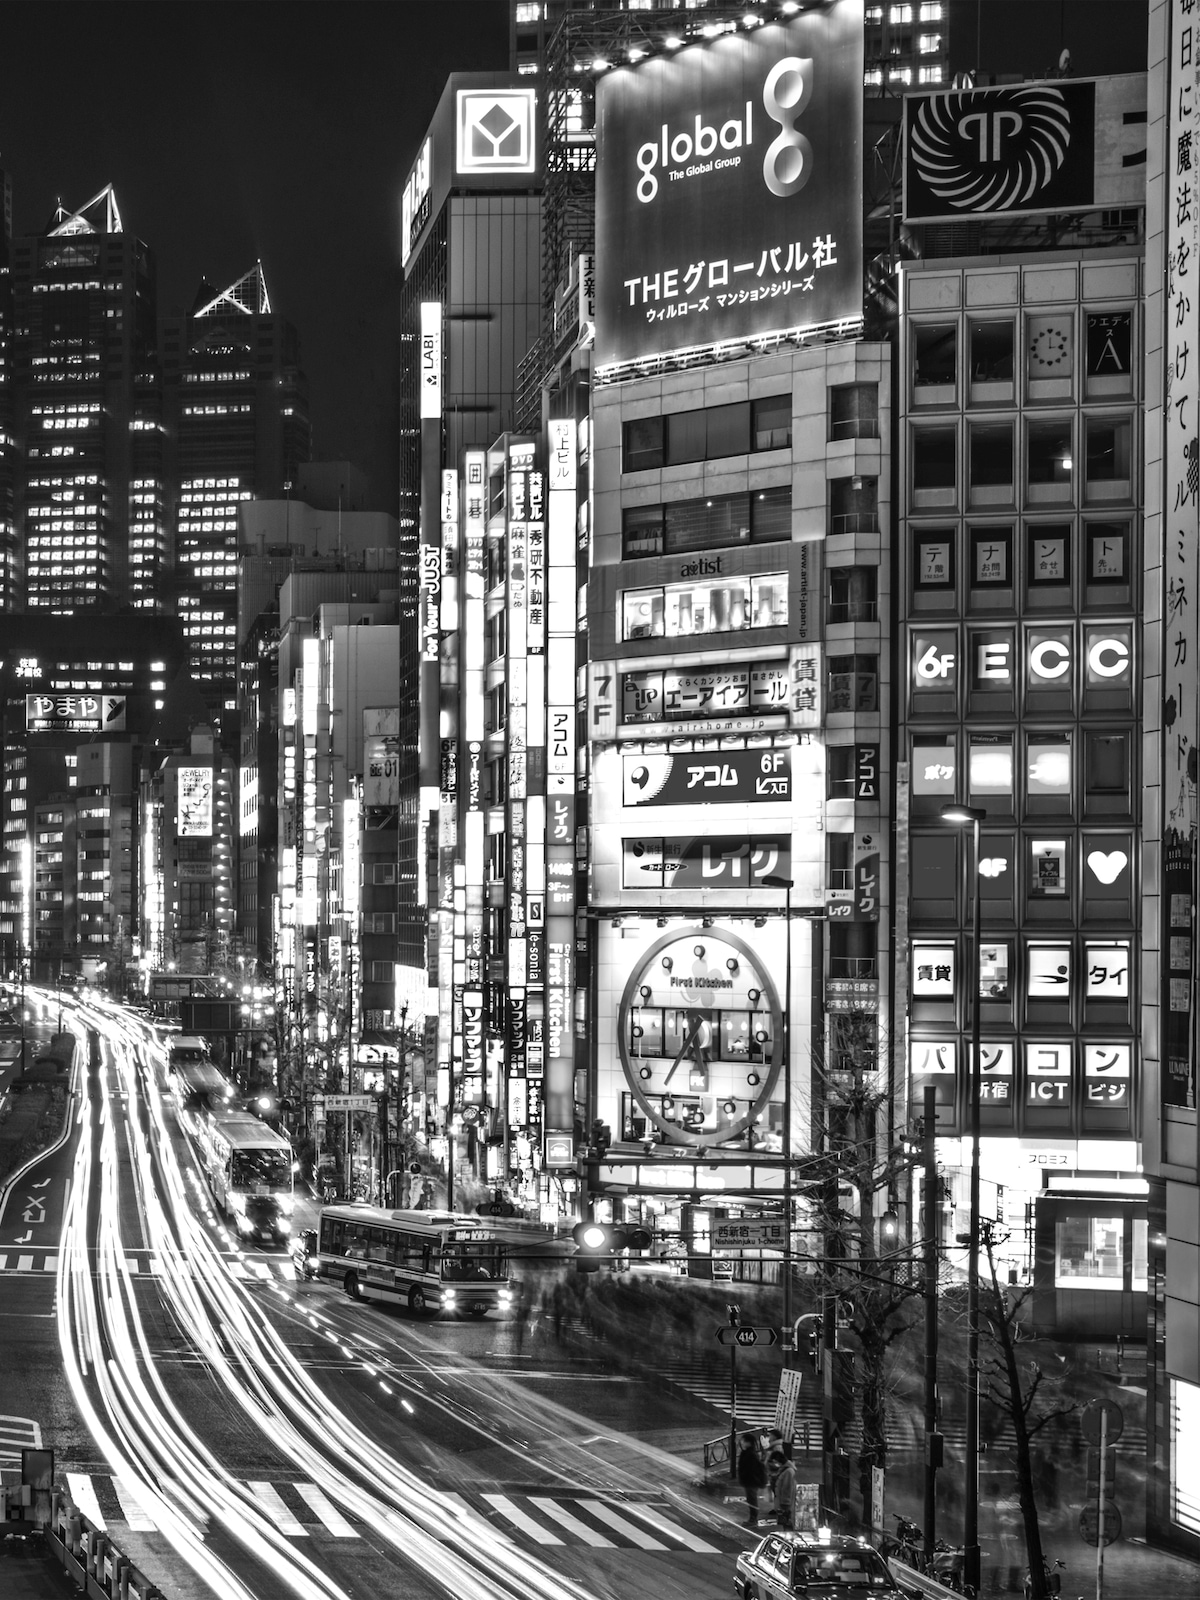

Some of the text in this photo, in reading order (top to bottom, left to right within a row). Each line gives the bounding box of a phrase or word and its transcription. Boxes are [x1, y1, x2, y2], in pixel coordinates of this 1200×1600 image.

[636, 101, 753, 203] global
[669, 155, 741, 181] The Global Group
[646, 274, 815, 323] ウィルローズ マンションシリーズ
[423, 334, 434, 369] LABI
[511, 455, 533, 465] DVD
[511, 526, 525, 559] 麻雀
[424, 545, 441, 594] JUST
[529, 530, 543, 625] 秀研不動産
[917, 645, 955, 679] 6F
[593, 675, 613, 726] 7F
[666, 681, 788, 709] エーアイアール
[790, 658, 819, 713] 賃貸
[34, 696, 98, 717] やまや
[554, 713, 569, 757] アコム
[687, 764, 738, 788] アコム
[760, 754, 784, 773] 6F
[858, 749, 875, 797] アコム
[770, 782, 788, 795] 入口
[554, 800, 569, 838] レイク
[646, 844, 681, 855] 新生銀行
[701, 843, 779, 878] レイク
[859, 867, 875, 913] レイク
[828, 905, 851, 916] レイク
[670, 976, 733, 988] First Kitchen
[917, 965, 952, 982] 賃貸
[549, 943, 564, 1058] First Kitchen
[465, 1008, 482, 1072] ソフマップ
[510, 1001, 524, 1050] ソフマップ
[1030, 1081, 1068, 1099] ICT
[1088, 1083, 1126, 1101] ビジ
[1028, 1154, 1068, 1164] プロミス
[719, 1226, 781, 1237] 西新宿一丁目
[738, 1331, 754, 1342] 414
